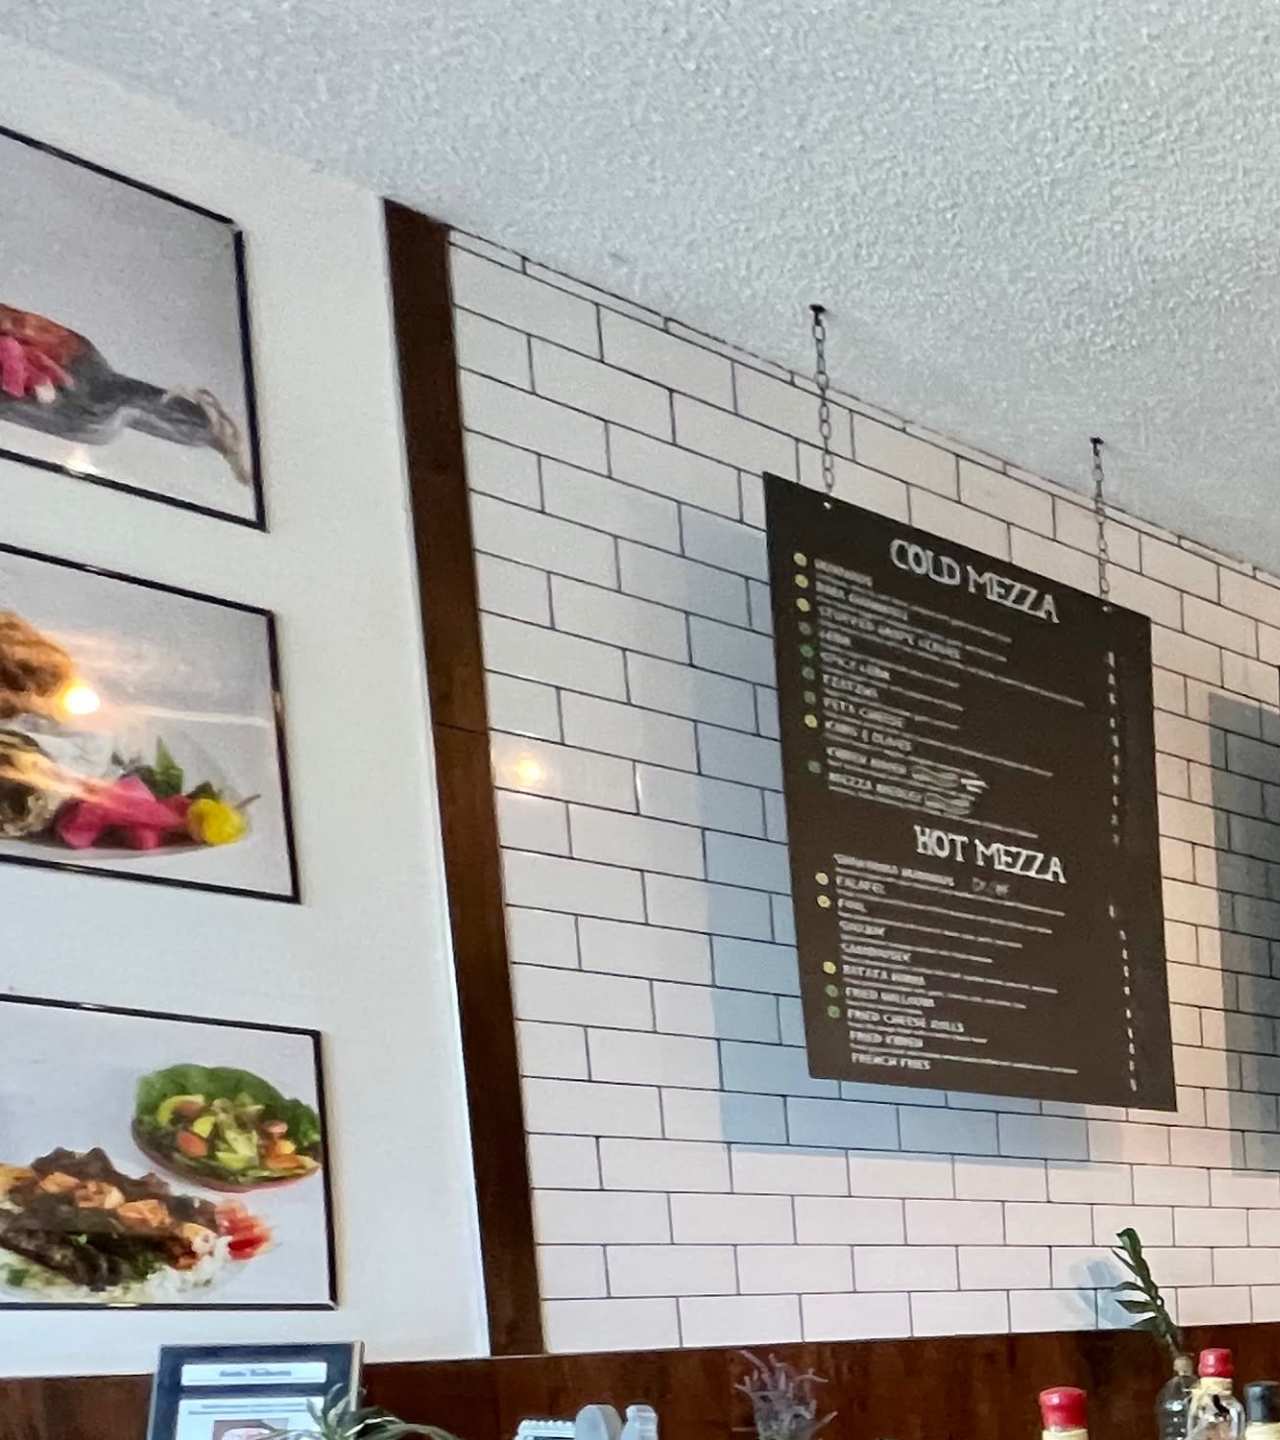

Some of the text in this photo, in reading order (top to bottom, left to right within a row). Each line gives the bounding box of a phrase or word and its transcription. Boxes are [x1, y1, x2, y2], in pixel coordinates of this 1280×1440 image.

[888, 538, 960, 586] COLD
[966, 564, 1060, 624] MEZZA
[913, 824, 1066, 884] HOT MEZZA
